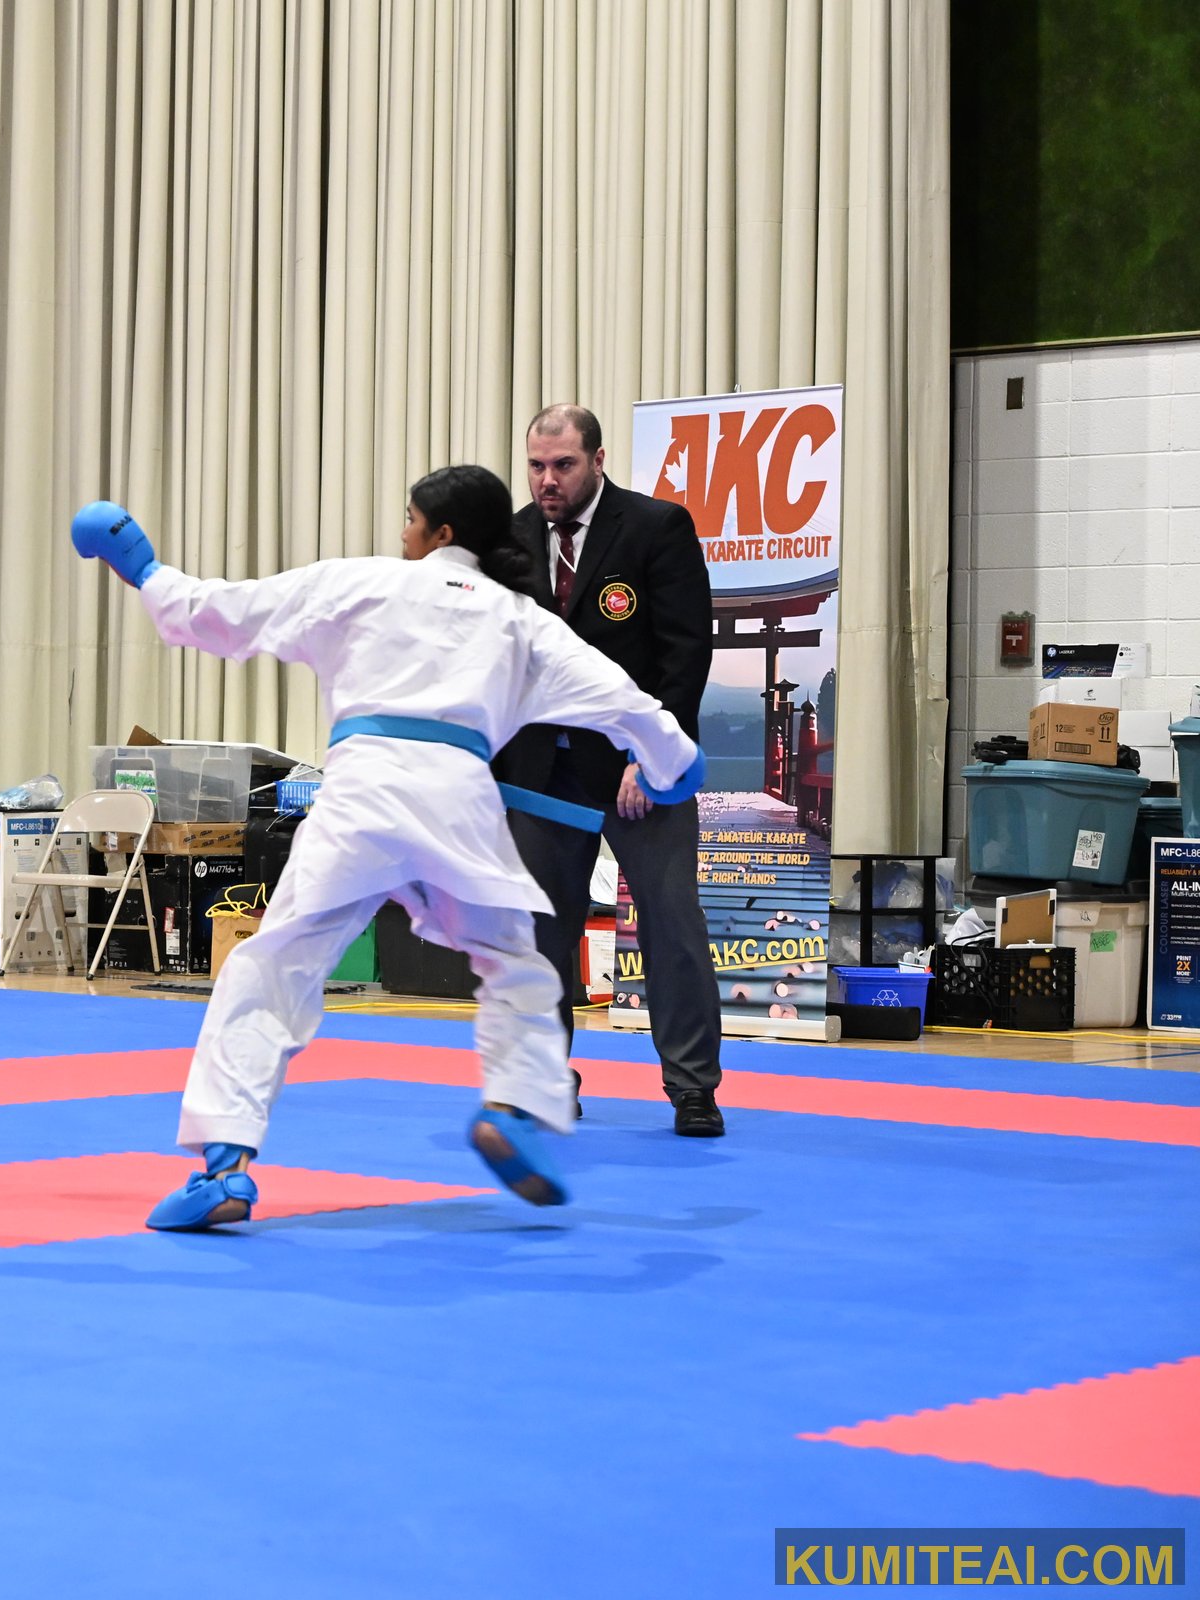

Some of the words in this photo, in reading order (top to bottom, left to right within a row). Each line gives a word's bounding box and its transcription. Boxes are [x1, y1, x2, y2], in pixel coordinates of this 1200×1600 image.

[653, 404, 836, 538] AKC
[706, 539, 764, 562] KARATE
[766, 535, 832, 560] CIRCUIT
[1056, 724, 1064, 732] 12
[702, 831, 714, 842] OF
[717, 831, 763, 843] AMATEUR
[766, 832, 806, 844] KARATE
[697, 851, 709, 863] ND
[713, 851, 751, 864] AROUND
[754, 852, 774, 864] THE
[777, 853, 810, 865] WORLD
[195, 861, 207, 878] hp
[697, 872, 708, 883] HE
[712, 872, 739, 884] RIGHT
[743, 873, 777, 885] HANDS
[1176, 961, 1190, 970] 2X
